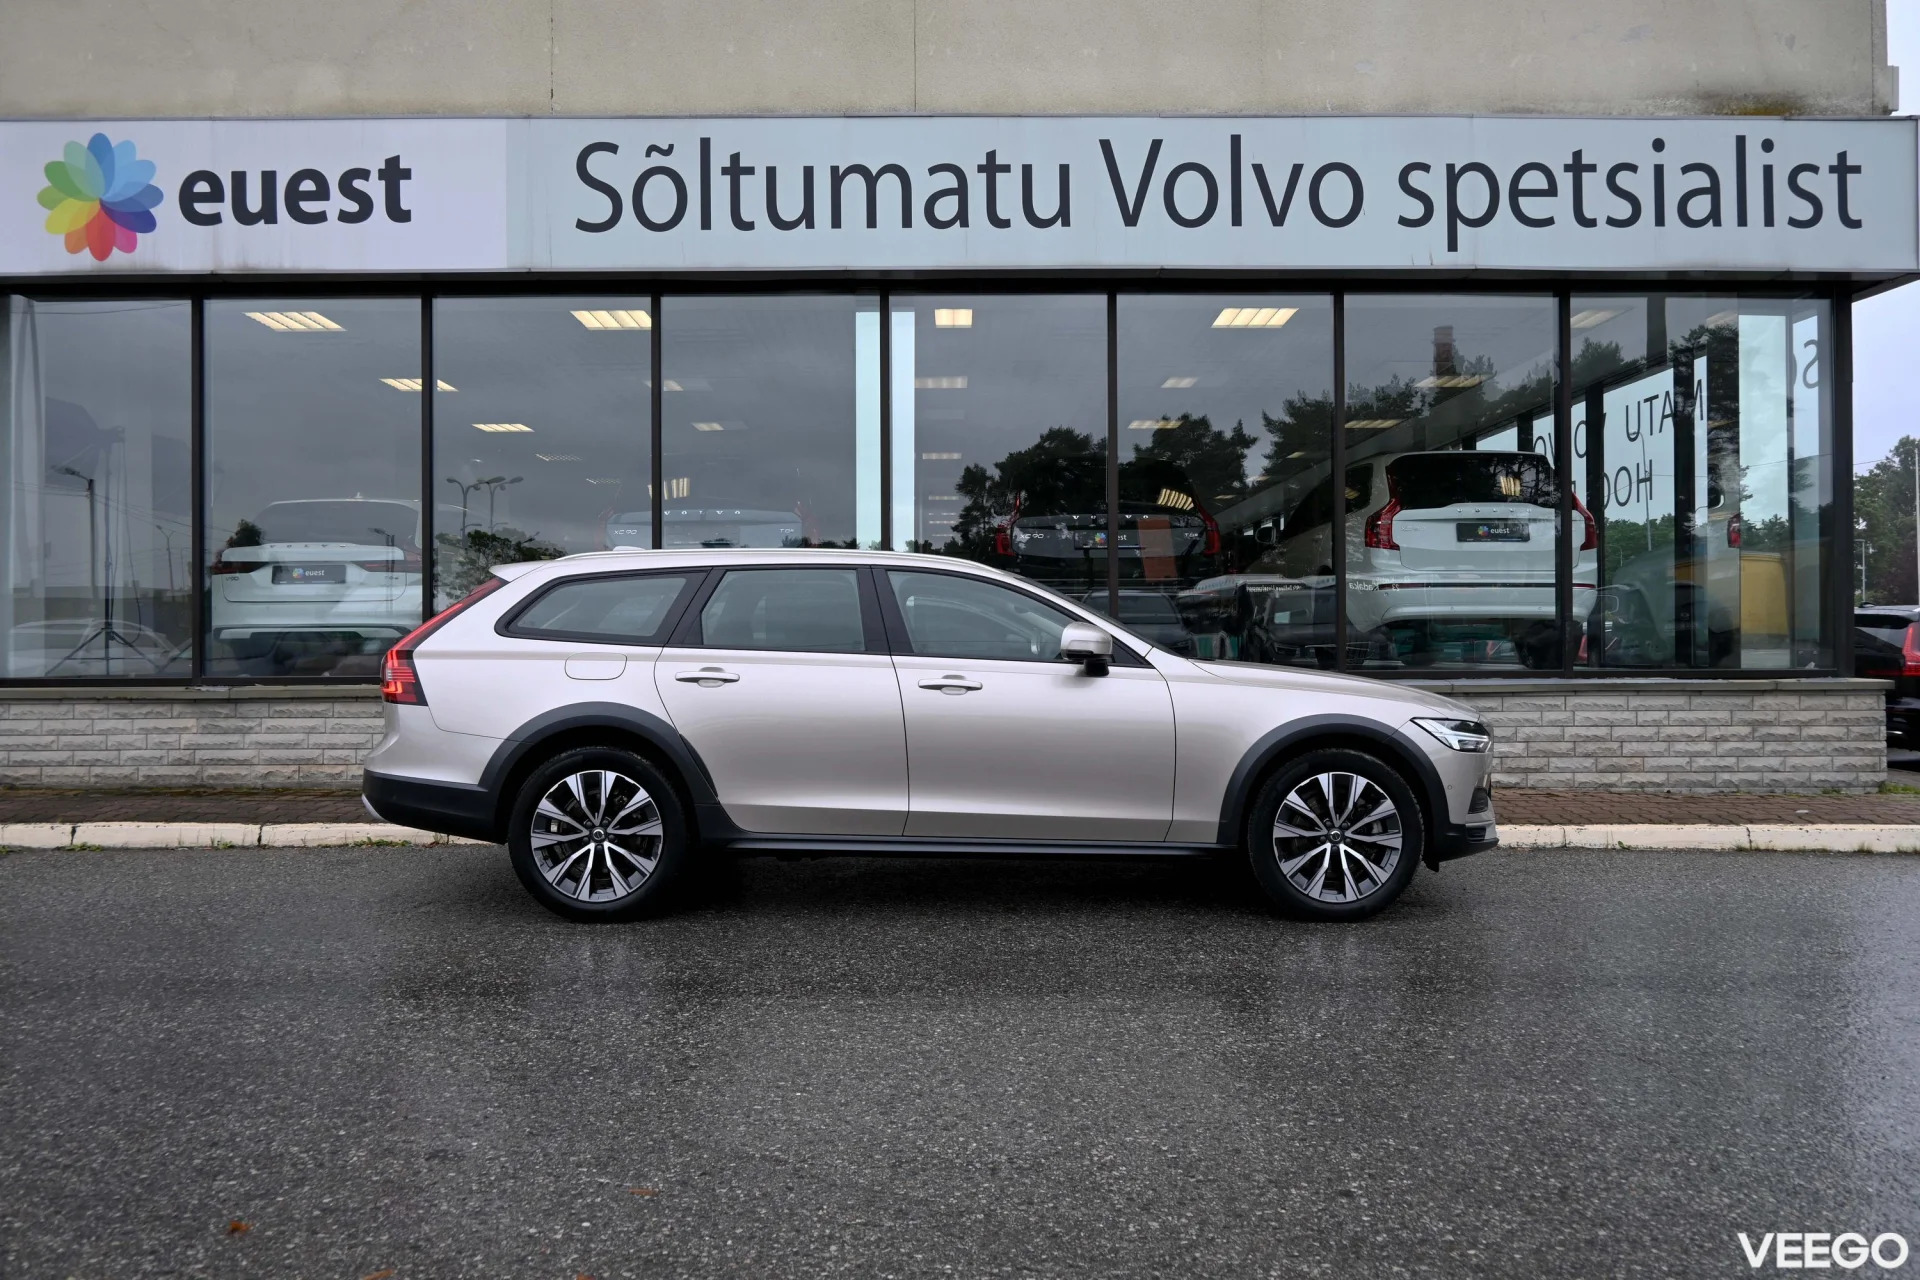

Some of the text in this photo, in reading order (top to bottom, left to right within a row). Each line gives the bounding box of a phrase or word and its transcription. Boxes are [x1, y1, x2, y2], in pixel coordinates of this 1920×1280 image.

[178, 154, 412, 227] euest
[575, 134, 1863, 253] Sõltumatu Volvo spetsialist
